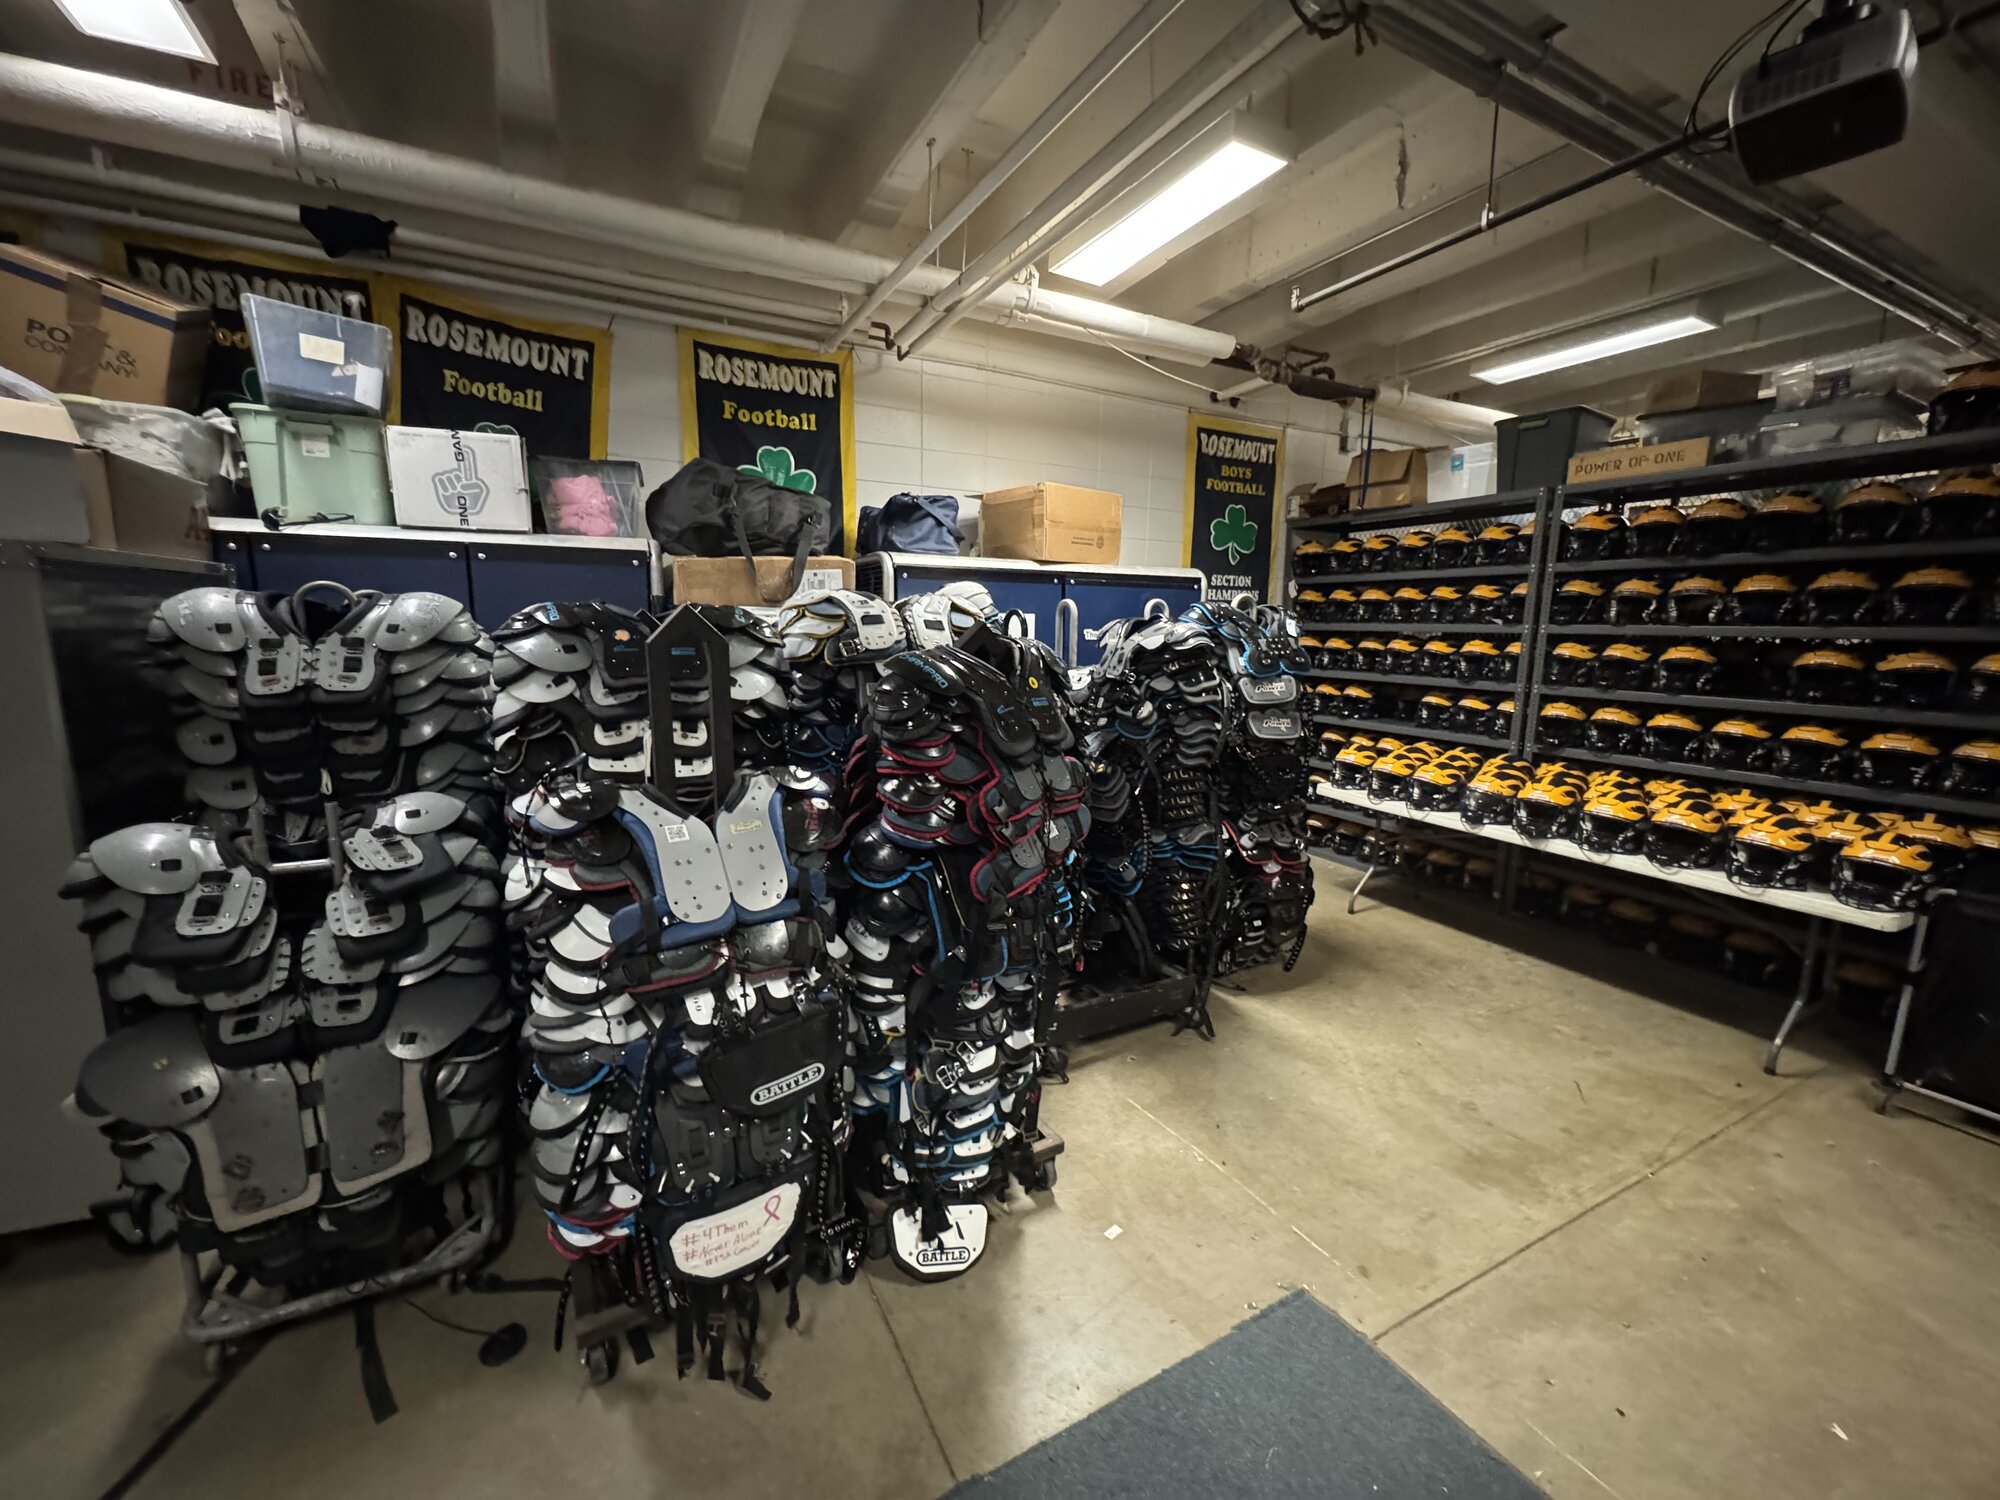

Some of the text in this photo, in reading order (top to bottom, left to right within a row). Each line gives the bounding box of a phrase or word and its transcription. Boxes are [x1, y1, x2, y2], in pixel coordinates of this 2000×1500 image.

[187, 61, 274, 99] FIRE
[405, 304, 590, 382] ROSEMOUNT
[697, 348, 836, 399] ROSEMOUNT
[442, 368, 544, 413] Football
[722, 400, 817, 431] Football
[1200, 432, 1276, 465] ROSEMOUNT
[1574, 459, 1623, 476] POWER
[1654, 450, 1686, 464] ONE
[1205, 478, 1266, 496] FOOTBALL
[1221, 465, 1253, 480] BOYS
[457, 495, 470, 527] ONE
[1210, 574, 1252, 588] SECTION
[900, 653, 949, 689] CHAMPRO
[757, 1067, 819, 1101] BATTLE
[921, 1250, 966, 1263] BATTLE
